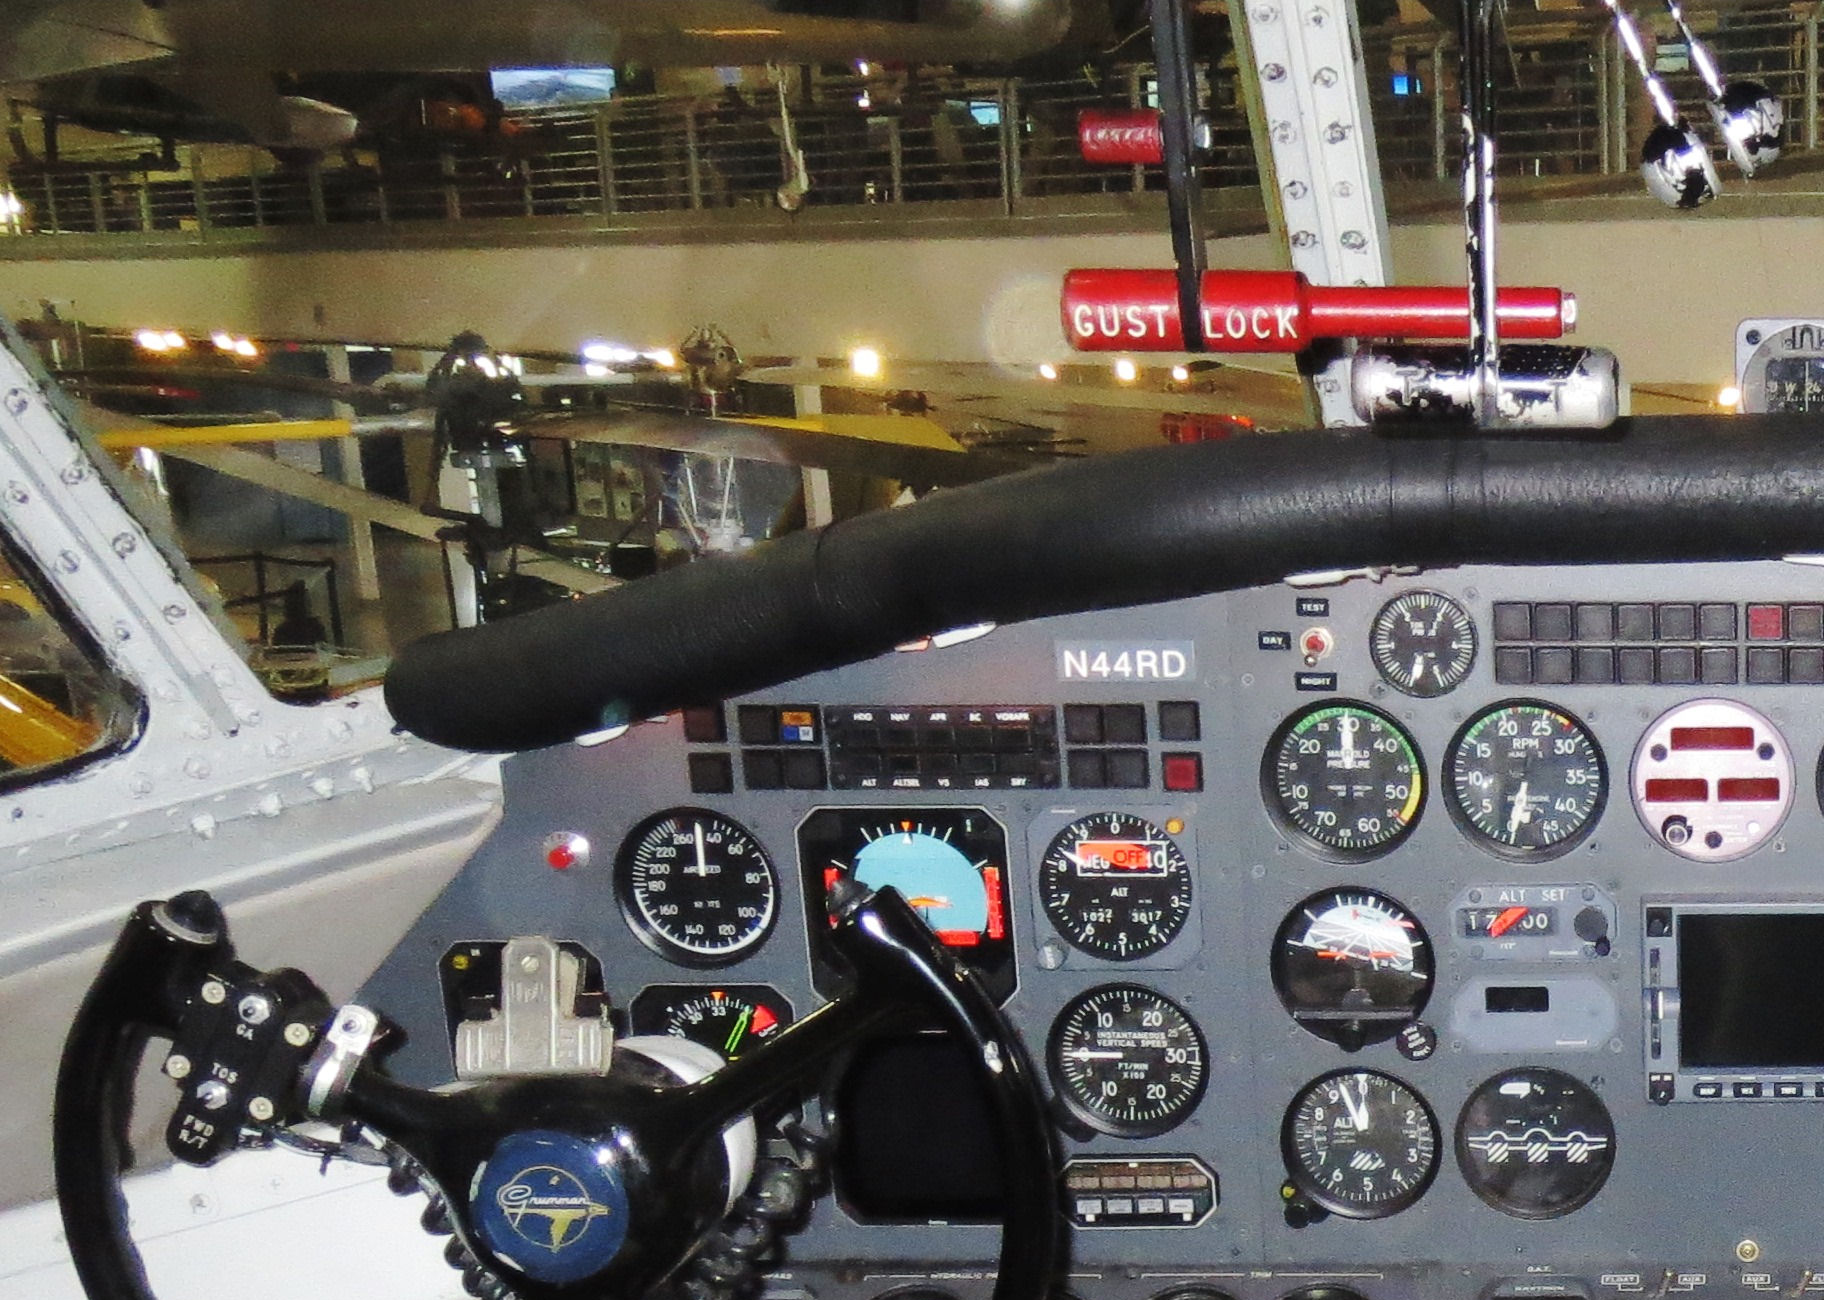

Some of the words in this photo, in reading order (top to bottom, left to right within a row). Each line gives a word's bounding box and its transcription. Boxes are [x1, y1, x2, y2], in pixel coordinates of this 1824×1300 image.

[1073, 304, 1171, 338] GUST
[1204, 306, 1298, 339] LOCK
[1263, 637, 1282, 645] DAY
[1064, 650, 1185, 677] N44RD
[1499, 718, 1517, 735] 20
[1532, 717, 1551, 735] 25
[1299, 739, 1320, 753] 20
[1374, 739, 1397, 752] 40
[1477, 743, 1491, 757] 15
[1513, 738, 1539, 749] RPM
[1554, 739, 1574, 754] 30
[1566, 770, 1586, 784] 35
[1293, 785, 1308, 798] 10
[1386, 785, 1408, 799] 50
[1555, 798, 1578, 815] 40
[1315, 811, 1336, 825] 70
[1358, 818, 1380, 832] 60
[653, 847, 676, 857] 220
[728, 844, 743, 854] 60
[1113, 850, 1142, 863] OFF
[647, 864, 669, 874] 200
[746, 873, 760, 883] 80
[1499, 889, 1525, 902] ALT
[1543, 889, 1564, 901] SET
[739, 907, 756, 917] 100
[719, 925, 735, 935] 120
[1098, 1013, 1113, 1028] 10
[1143, 1011, 1162, 1026] 20
[1097, 1039, 1136, 1047] VERTICAL
[1166, 1048, 1186, 1063] 30
[213, 1062, 238, 1084] TOS
[498, 1185, 590, 1227] Grumman
